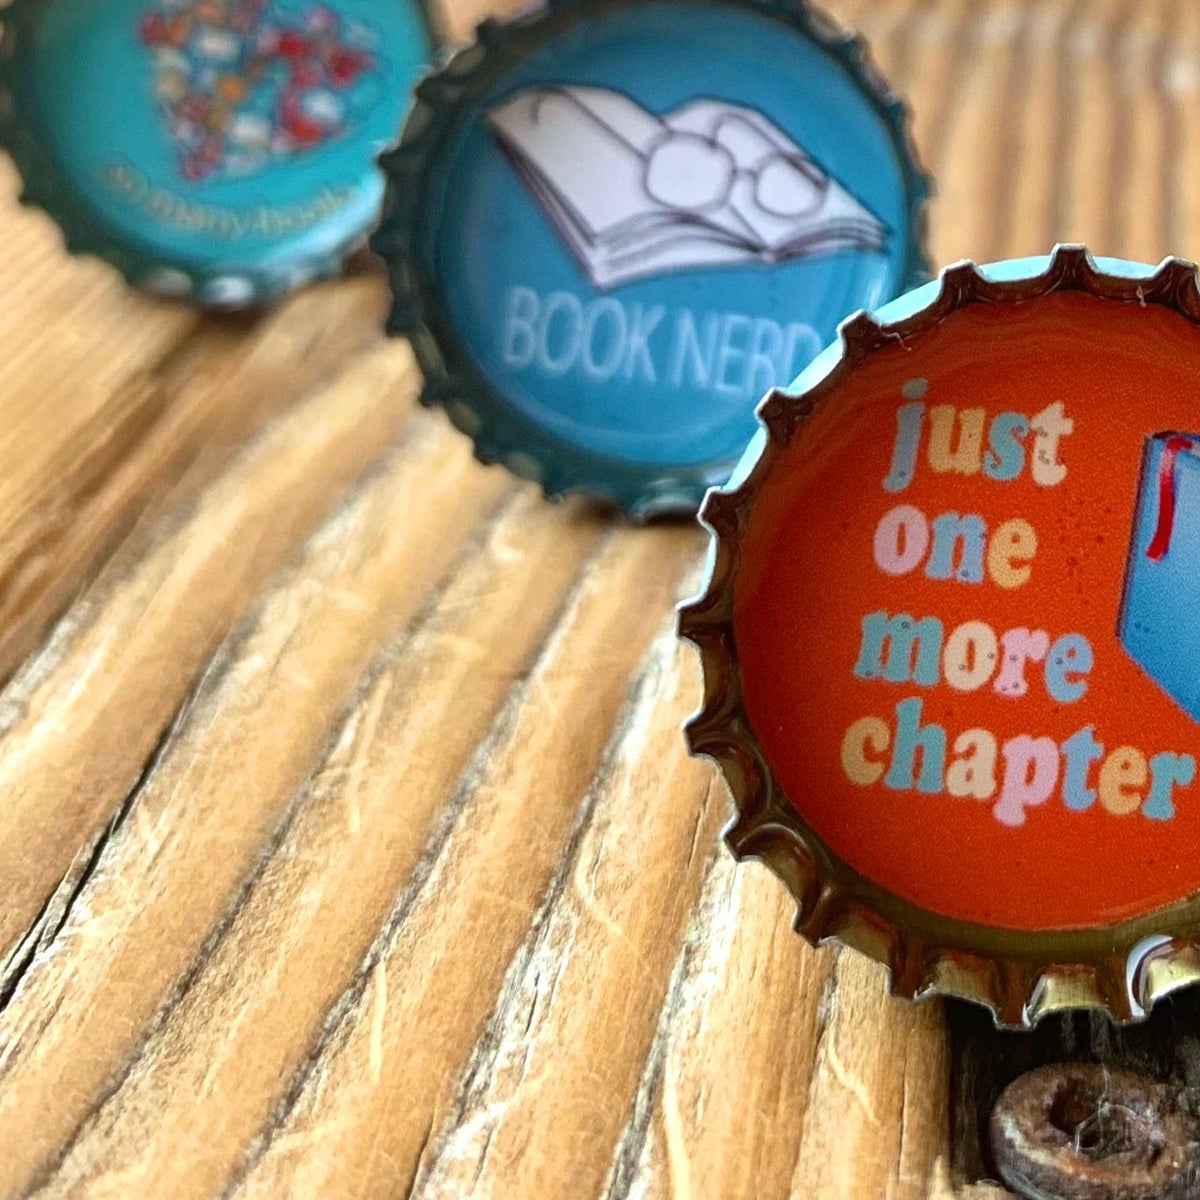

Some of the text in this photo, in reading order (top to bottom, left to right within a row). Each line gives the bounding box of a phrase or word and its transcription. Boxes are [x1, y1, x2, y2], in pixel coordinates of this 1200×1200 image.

[502, 286, 666, 385] BOOK
[882, 378, 1074, 493] just
[873, 504, 1038, 589] one
[853, 610, 1094, 703] more
[840, 696, 1197, 828] chapter
